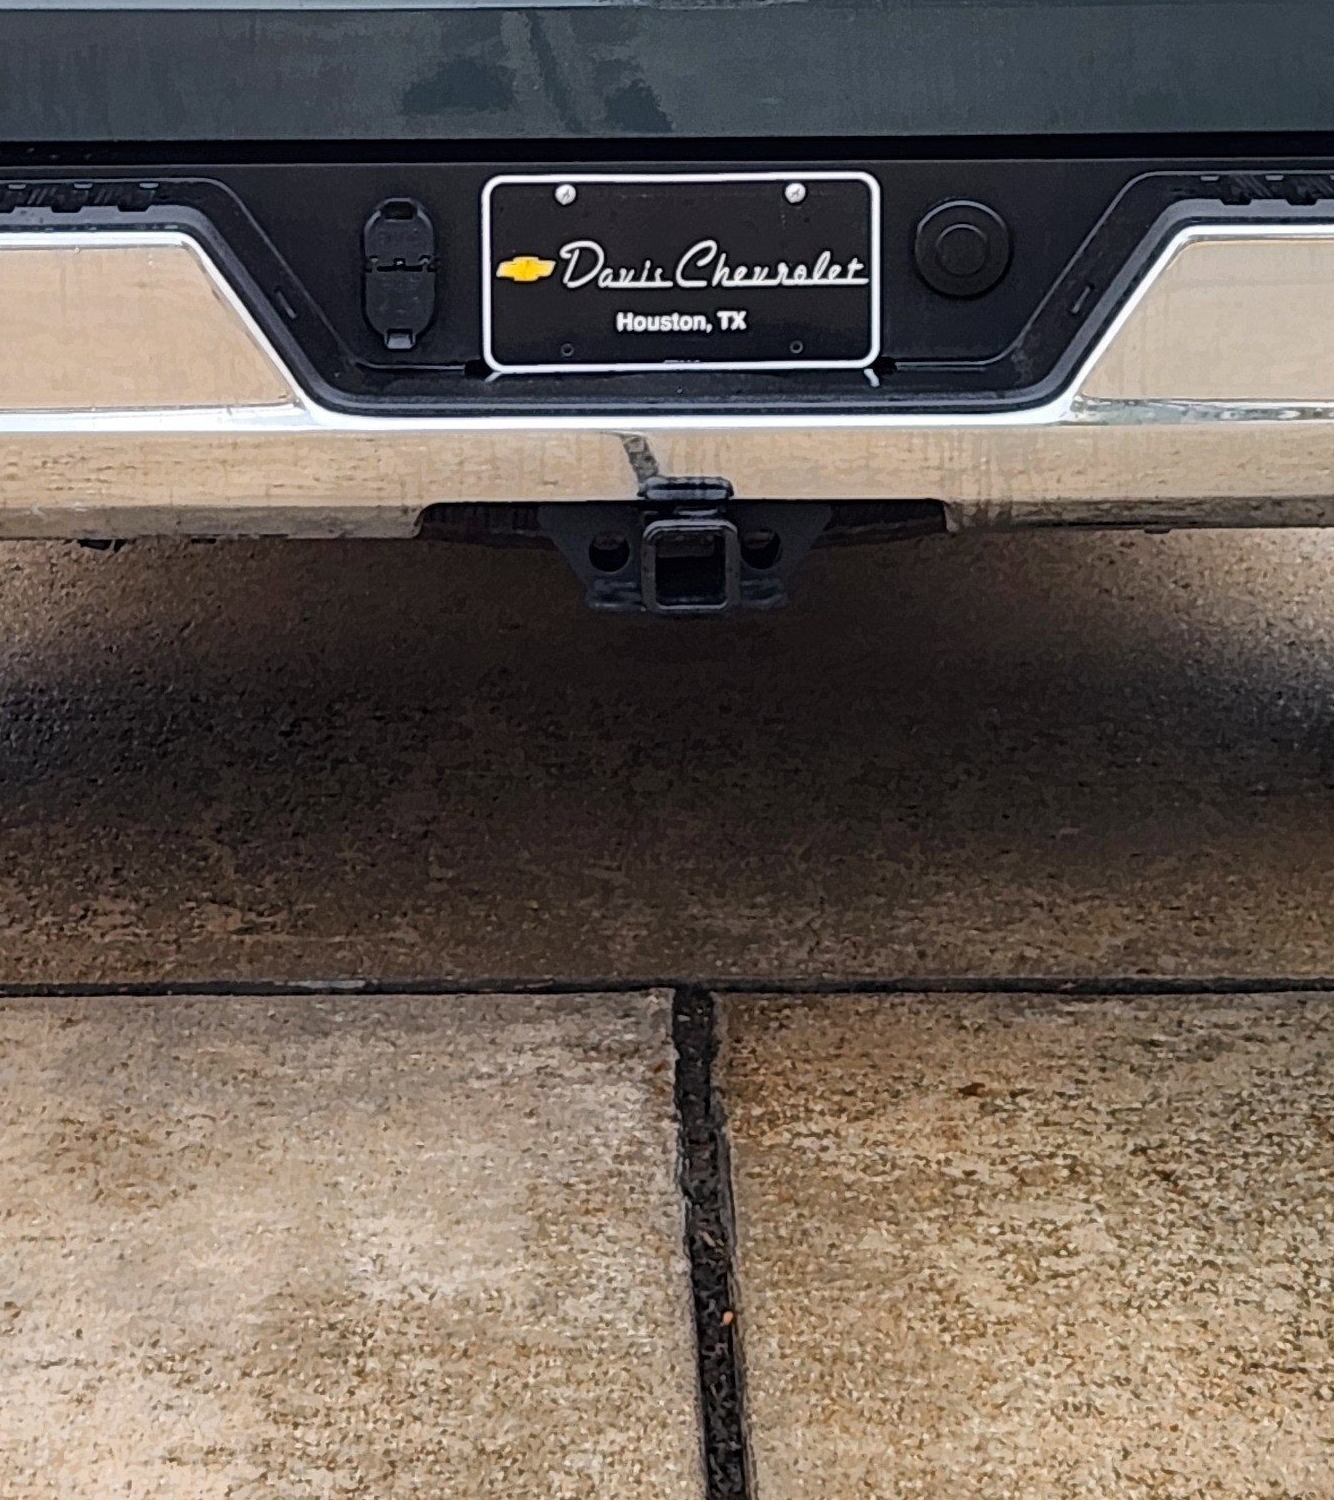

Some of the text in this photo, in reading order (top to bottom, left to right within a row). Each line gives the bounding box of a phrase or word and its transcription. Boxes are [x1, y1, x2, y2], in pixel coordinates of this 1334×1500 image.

[559, 240, 869, 289] Davis Chevrolet
[616, 311, 747, 333] Houston, TX
